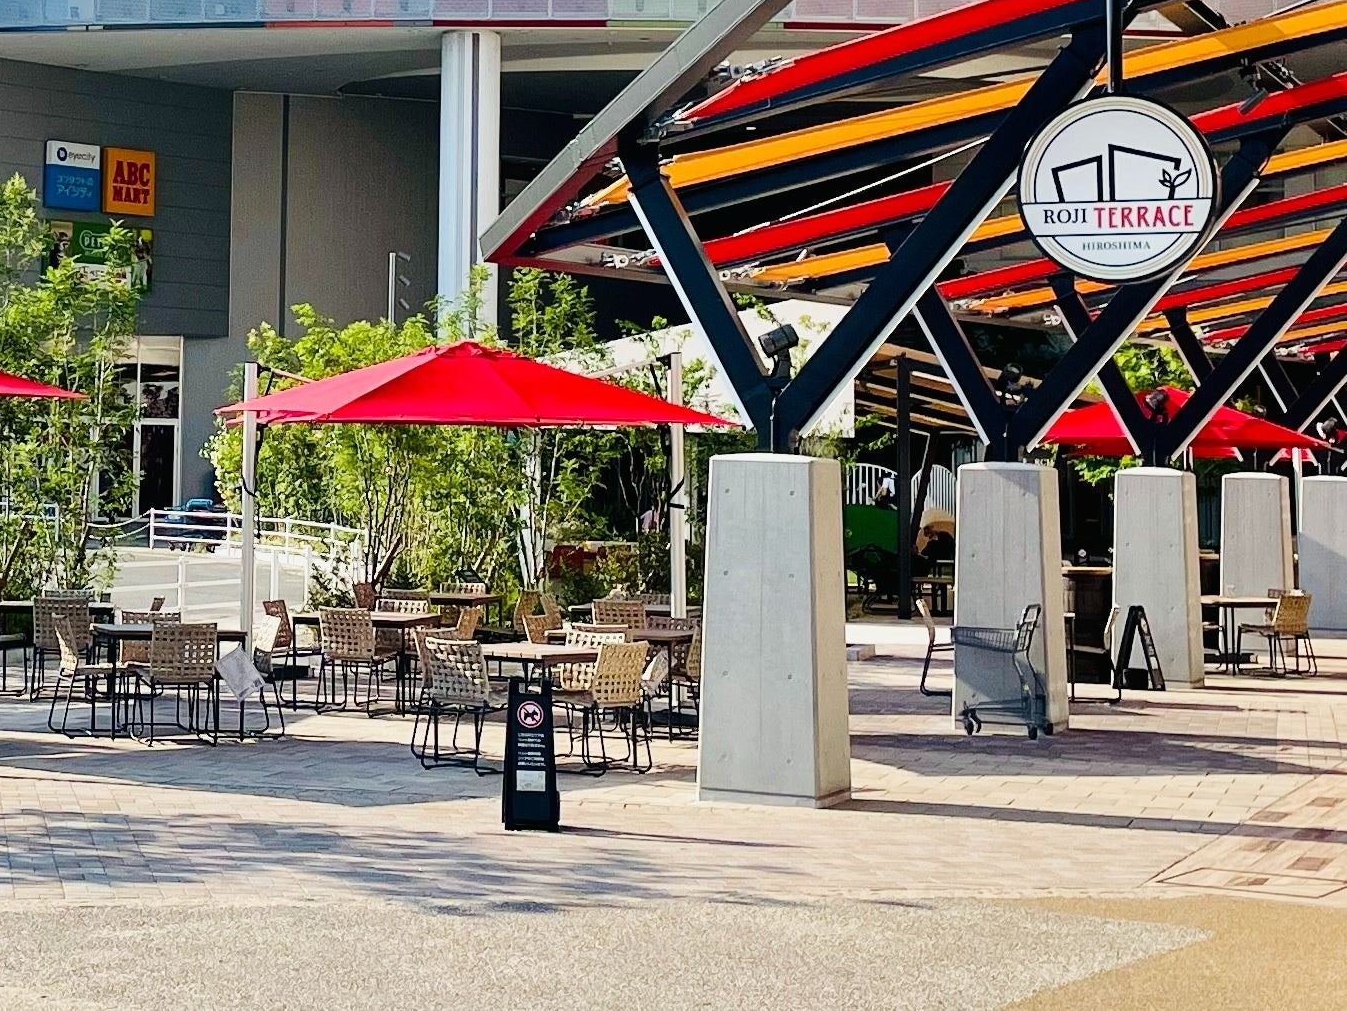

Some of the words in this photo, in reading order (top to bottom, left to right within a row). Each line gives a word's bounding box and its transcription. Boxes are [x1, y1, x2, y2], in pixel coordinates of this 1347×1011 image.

[112, 160, 151, 187] ABC
[112, 186, 150, 205] MART
[1043, 208, 1088, 225] ROJI
[1093, 204, 1194, 229] TERRACE
[1082, 240, 1151, 251] HIROSHIMA
